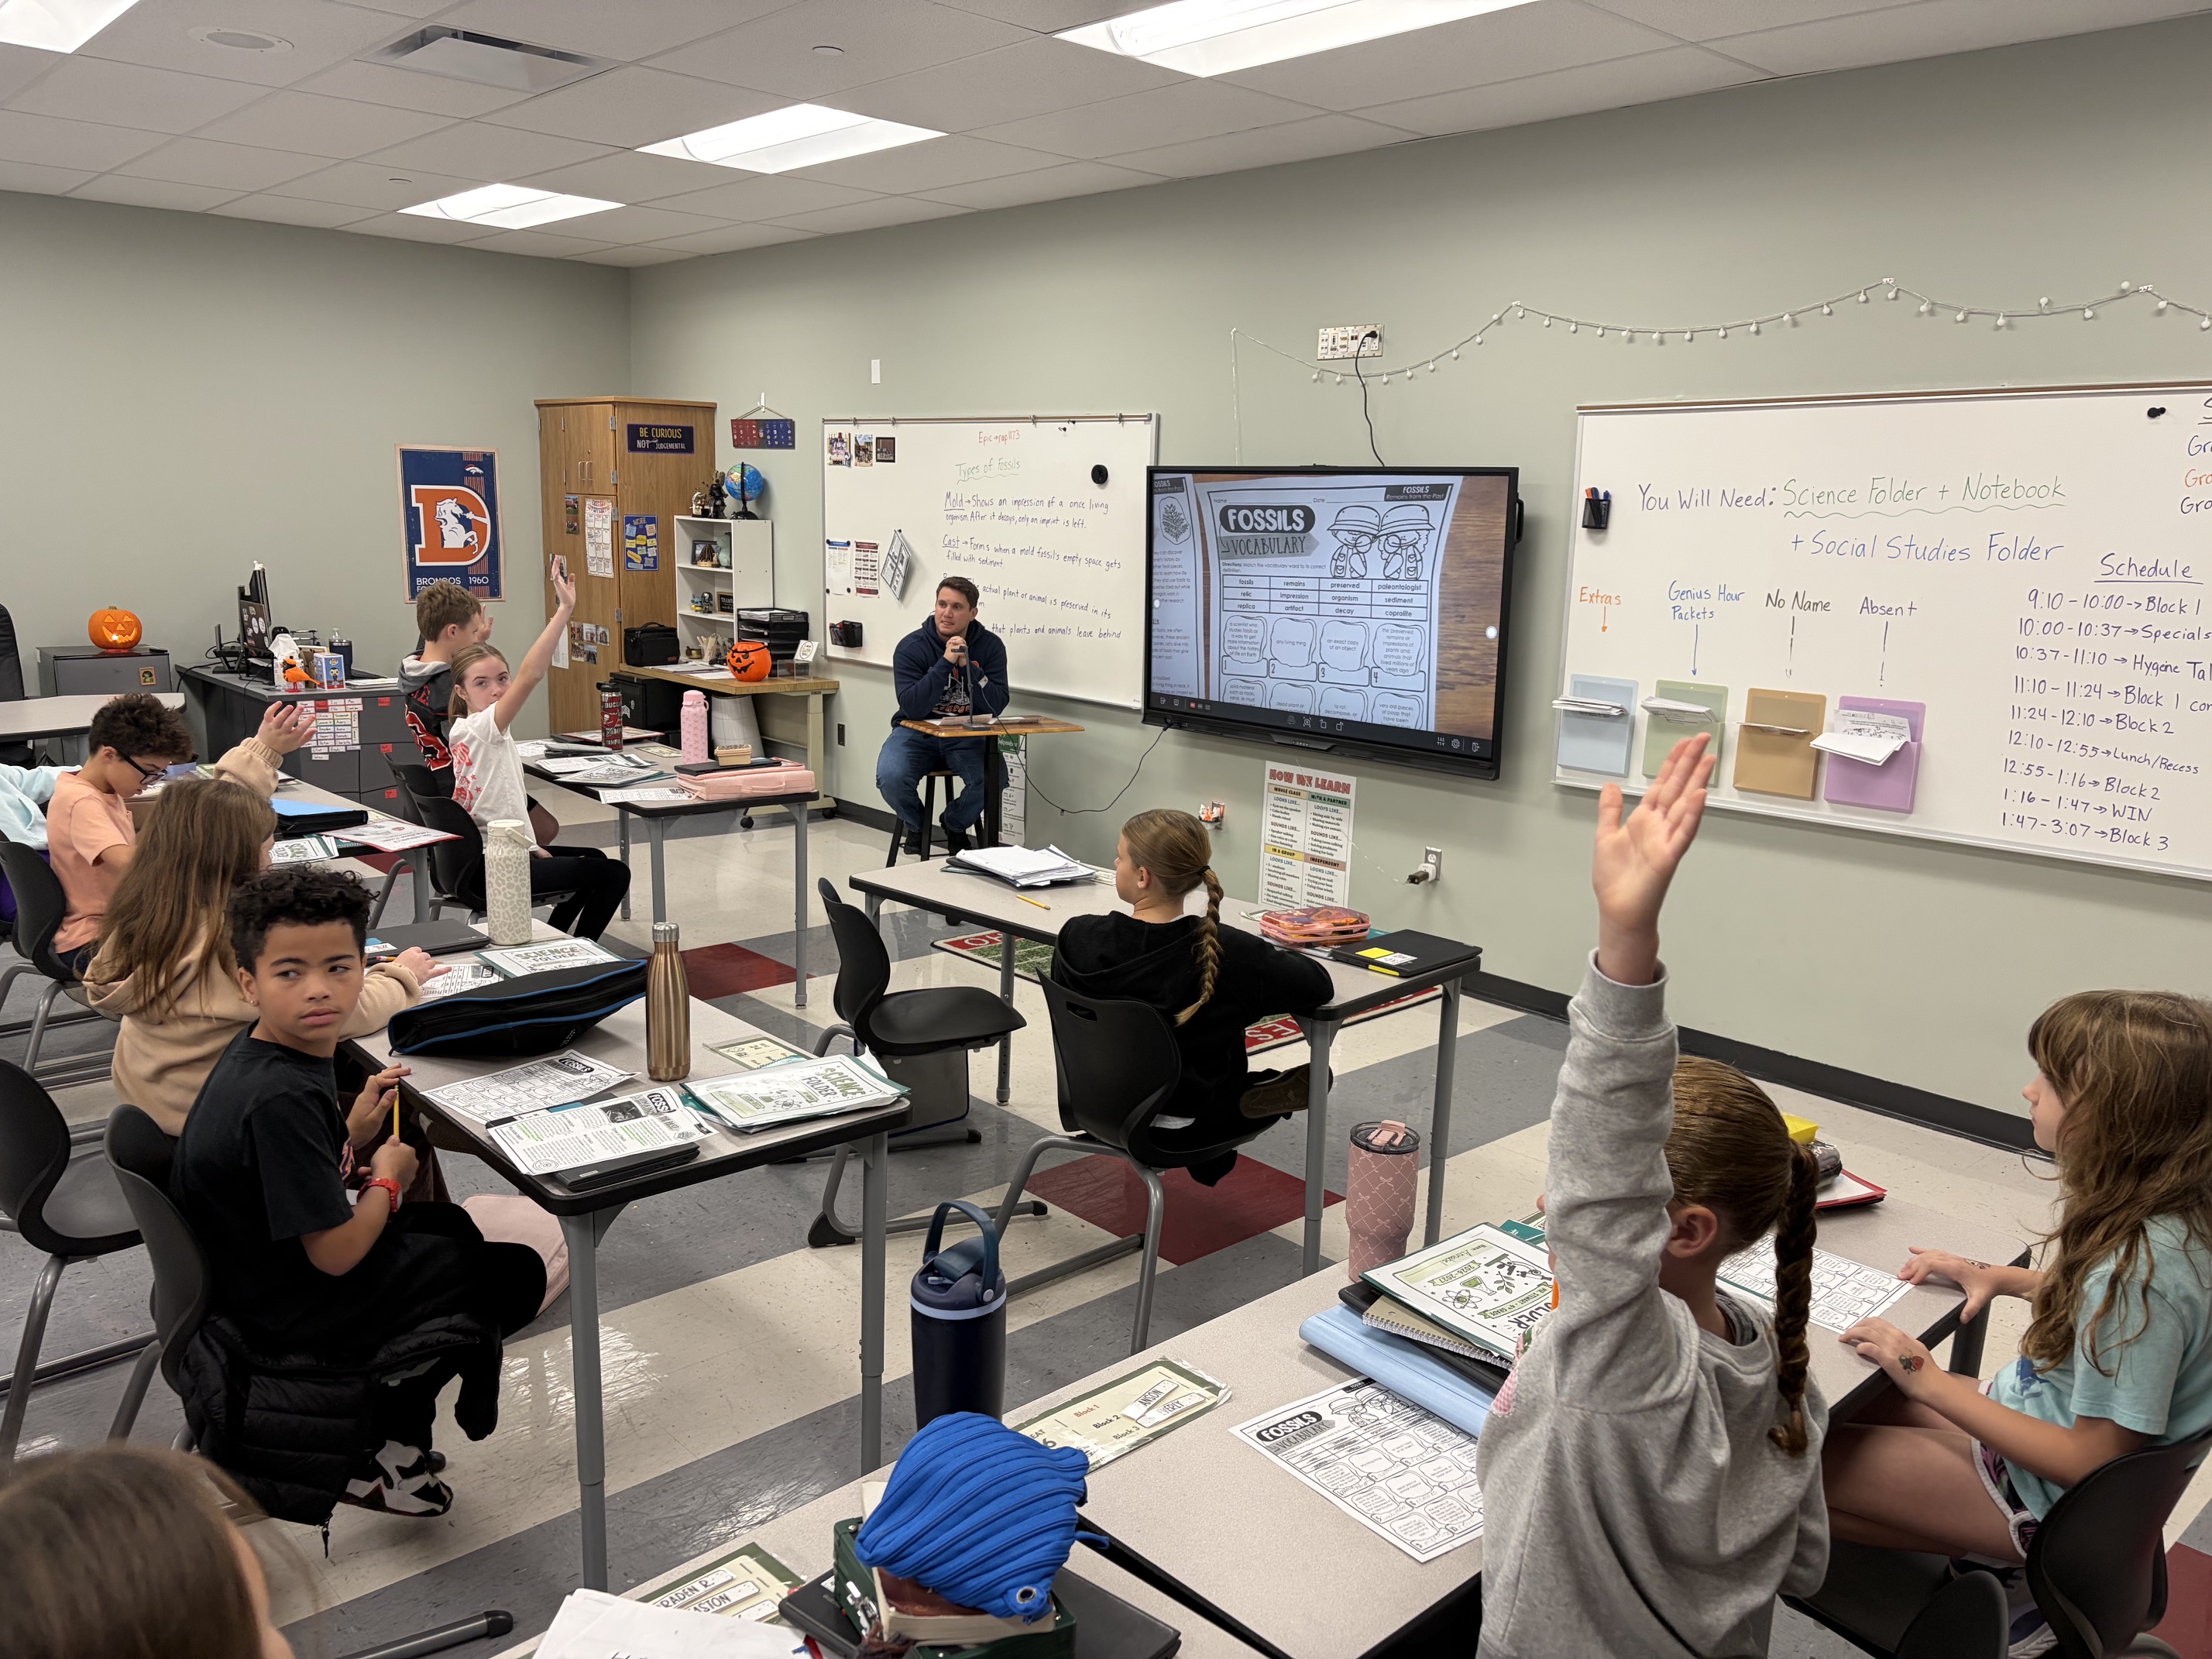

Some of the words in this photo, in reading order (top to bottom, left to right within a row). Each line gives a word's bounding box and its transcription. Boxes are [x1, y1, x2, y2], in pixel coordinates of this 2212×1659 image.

[639, 427, 648, 437] BE
[651, 428, 682, 439] CURIOUS
[978, 431, 993, 446] Epic
[637, 439, 650, 448] NOT
[956, 462, 980, 479] Types
[984, 457, 994, 471] of
[998, 458, 1021, 472] Fossils
[1402, 486, 1430, 494] FOSSILS
[1638, 485, 1669, 512] You
[1679, 487, 1710, 508] Will
[1719, 485, 1778, 510] Need:
[1783, 483, 1859, 507] Science
[1869, 476, 1928, 503] Folder
[1962, 472, 2066, 502] Notebook
[945, 491, 964, 508] Mold
[971, 493, 994, 507] Shows
[998, 498, 1007, 507] an
[1012, 496, 1044, 510] impression
[1047, 496, 1056, 507] of
[1069, 500, 1085, 509] once
[1089, 498, 1109, 515] living
[970, 510, 988, 523] After
[990, 511, 996, 521] it
[1018, 514, 1029, 525] only
[1039, 517, 1060, 529] imprint
[1063, 518, 1070, 527] is
[1071, 518, 1087, 529] left.
[1227, 508, 1306, 531] FOSSILS
[943, 534, 960, 547] Cast
[970, 537, 991, 551] Forms
[994, 544, 1010, 555] when
[1019, 545, 1035, 556] mold
[1063, 553, 1082, 567] empty
[1084, 556, 1102, 568] space
[1105, 558, 1121, 572] gets
[1231, 536, 1307, 556] VOCABULARY
[1811, 531, 1877, 559] Social
[1887, 533, 1970, 562] Studies
[1987, 531, 2065, 562] Folder
[946, 550, 962, 562] filled
[963, 552, 976, 563] with
[978, 555, 1005, 569] sediment.
[2100, 551, 2193, 579] Schedule
[1330, 582, 1360, 590] preserved
[1377, 583, 1422, 592] paleontologist
[1579, 586, 1621, 606] Extras
[1668, 580, 1711, 601] Genius
[1718, 583, 1746, 602] Hour
[982, 583, 1001, 596] actual
[1003, 587, 1020, 600] plant
[1029, 593, 1047, 604] animal
[1050, 596, 1058, 606] is
[1060, 599, 1089, 613] preserved
[1091, 605, 1099, 616] in
[1101, 609, 1112, 620] its
[1279, 592, 1309, 601] impression
[1765, 589, 1786, 609] No
[1791, 590, 1832, 614] Name
[1859, 595, 1918, 617] Absent
[2145, 596, 2188, 615] Block
[1334, 607, 1355, 616] decay
[1671, 605, 1715, 621] Packets
[991, 623, 1006, 634] that
[1010, 623, 1031, 639] plants
[1034, 626, 1046, 634] and
[1048, 626, 1072, 636] animals
[1077, 627, 1094, 638] leave
[1098, 628, 1122, 639] behind
[2141, 624, 2212, 644] Specials
[2186, 661, 2212, 682] Tal
[2124, 685, 2164, 708] Block
[2115, 713, 2159, 733] Block
[2162, 721, 2175, 734] 2
[2113, 747, 2200, 775] Lunch/Recess
[1269, 768, 1294, 784] HOW
[1314, 777, 1352, 795] LEARN
[2104, 776, 2148, 798] Block
[2151, 787, 2162, 801] 2
[1288, 788, 1301, 797] CLASS
[1328, 797, 1348, 805] PARTNER
[2112, 803, 2153, 823] WIN
[2109, 827, 2151, 848] Block
[2158, 836, 2169, 851] 3
[1310, 857, 1340, 867] INDEPENDENT
[514, 946, 580, 960] SCIENCE
[533, 953, 577, 963] FOLDER
[561, 1059, 591, 1073] FOSSILS
[802, 1076, 837, 1097] FOLDER
[816, 1067, 866, 1097] SCIENCE
[1438, 1263, 1475, 1283] 2026-2027
[1519, 1292, 1540, 1306] STEWART
[1489, 1307, 1508, 1317] GRADE
[1508, 1302, 1552, 1329] OLDER
[1138, 1389, 1164, 1407] ANSON
[1156, 1400, 1184, 1416] EVERLY
[1074, 1407, 1094, 1418] Block
[1093, 1417, 1112, 1429] Block
[1260, 1413, 1317, 1440] FOSSILS
[1030, 1428, 1046, 1440] EAT
[1113, 1429, 1132, 1440] Block
[1276, 1421, 1330, 1449] VOCABULARY
[660, 1585, 700, 1609] RADEN
